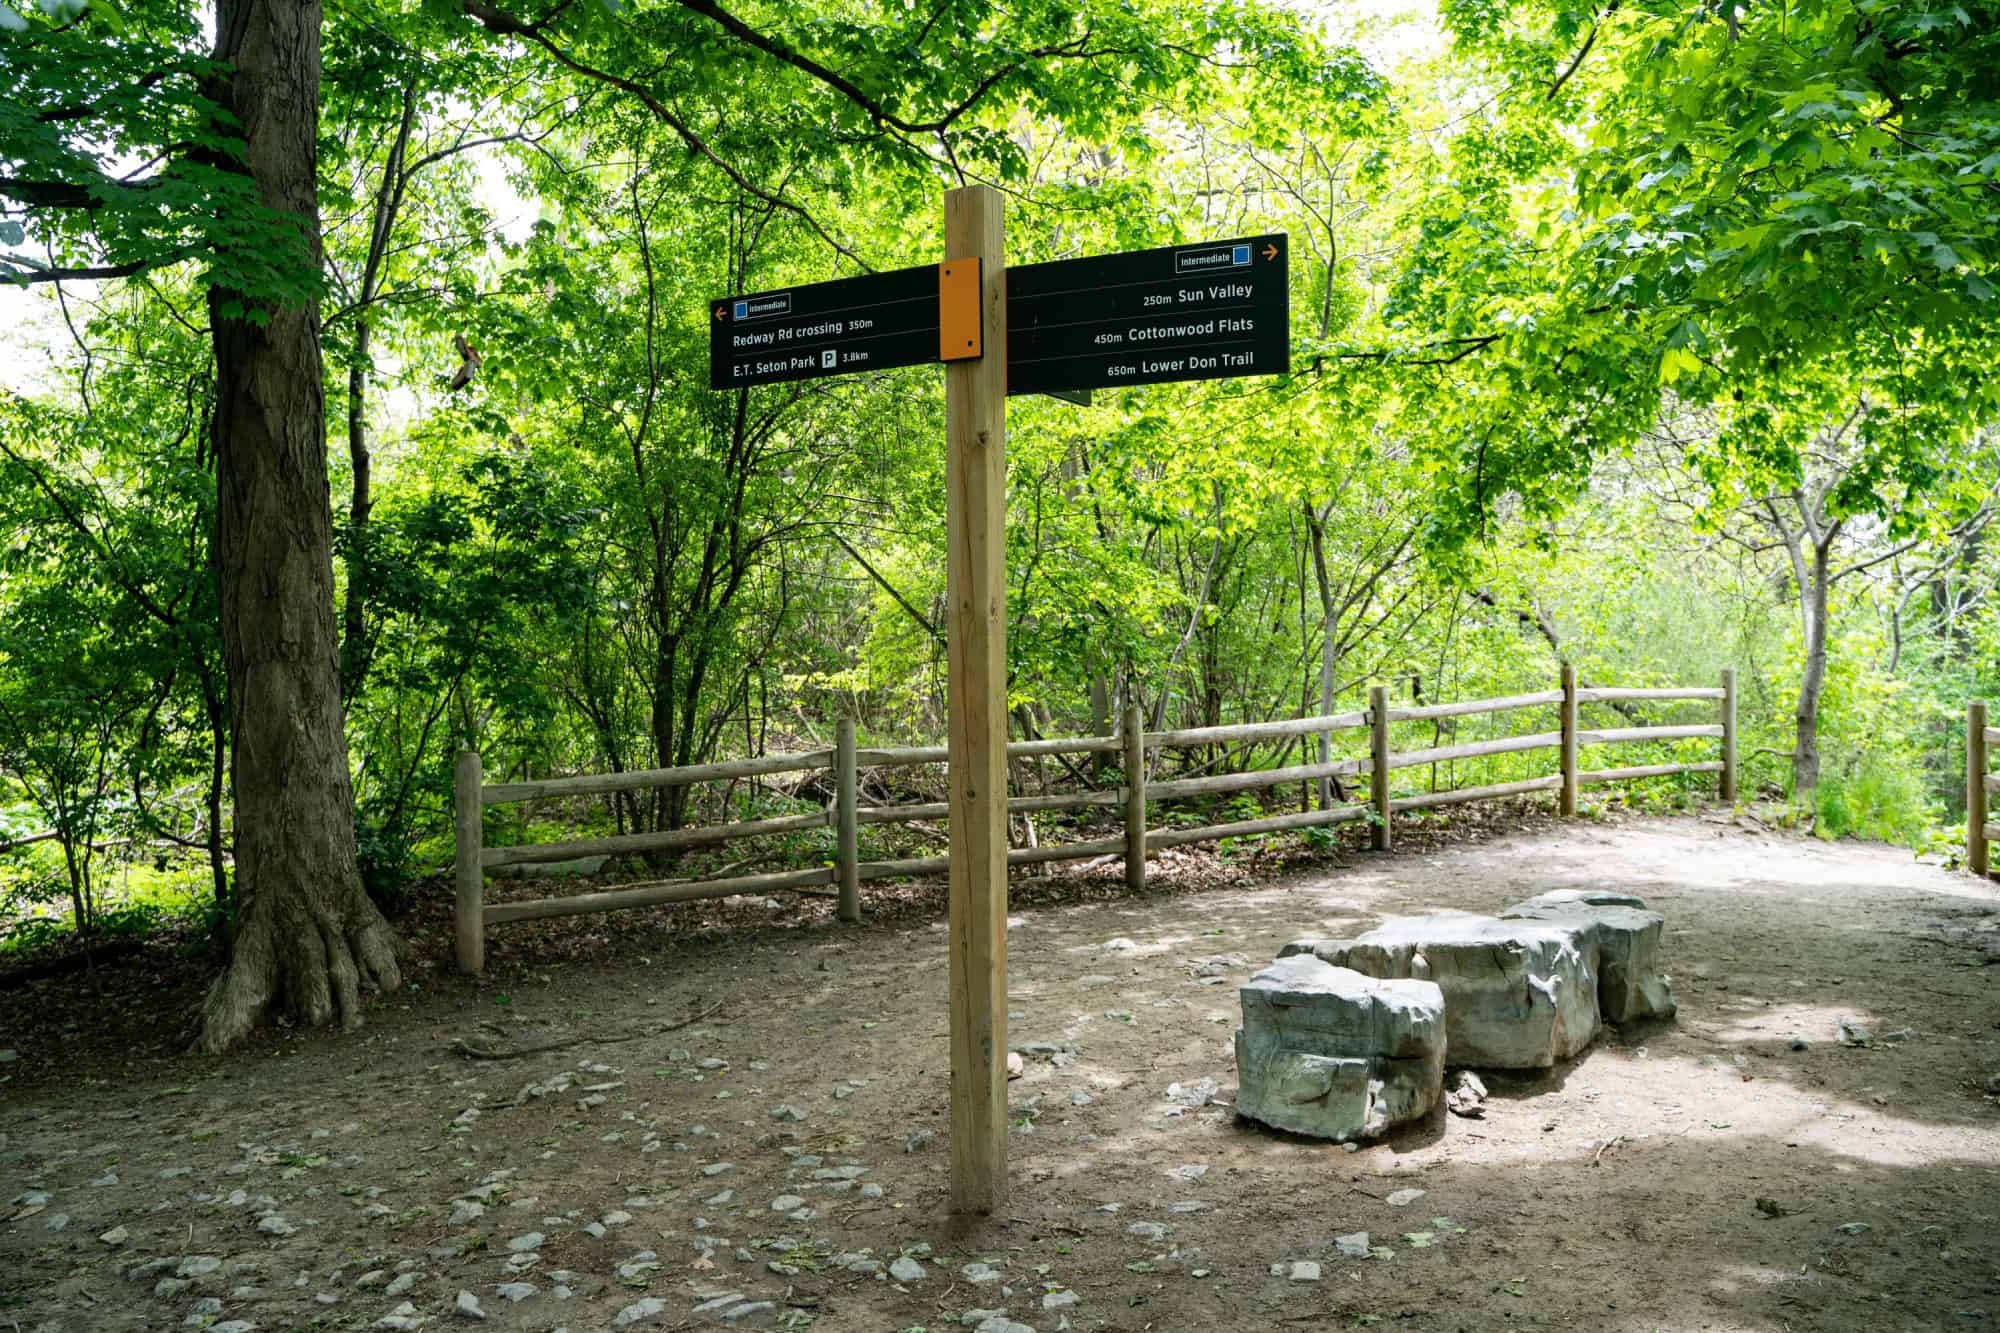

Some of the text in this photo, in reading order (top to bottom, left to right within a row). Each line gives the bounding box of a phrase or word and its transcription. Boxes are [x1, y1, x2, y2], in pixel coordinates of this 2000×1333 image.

[1143, 284, 1253, 306] 250m Sun Valley
[734, 320, 873, 347] Redway Rd crossing 350m
[1094, 319, 1253, 344] 450m Cottonwood Flats
[734, 351, 868, 376] E.T. Seton Park P 3.8km
[1108, 352, 1254, 376] 650m Lower Don Trail
